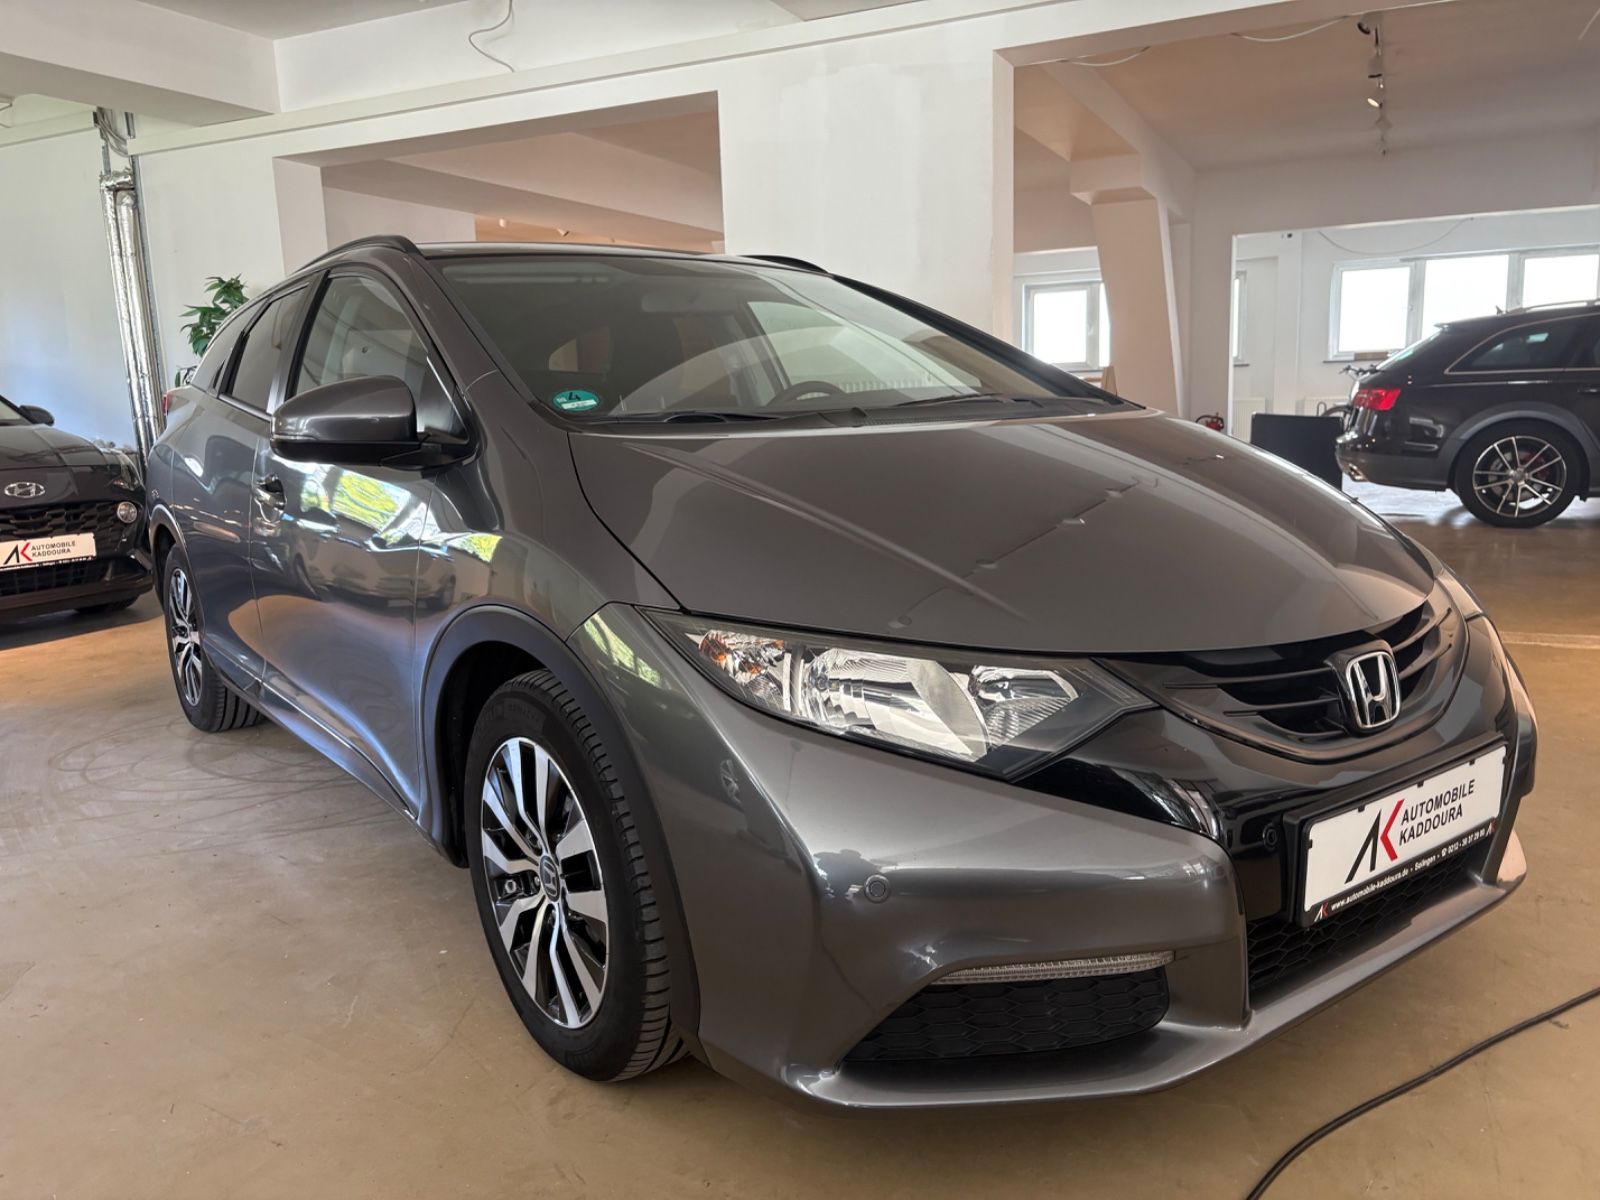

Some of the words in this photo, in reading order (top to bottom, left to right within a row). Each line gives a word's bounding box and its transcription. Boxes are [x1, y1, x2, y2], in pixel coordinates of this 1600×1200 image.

[31, 540, 76, 551] AUTOMOBILE
[31, 548, 71, 557] KADDOURA
[1401, 779, 1475, 826] AUTOMOBILE
[1399, 803, 1463, 846] KADDOURA
